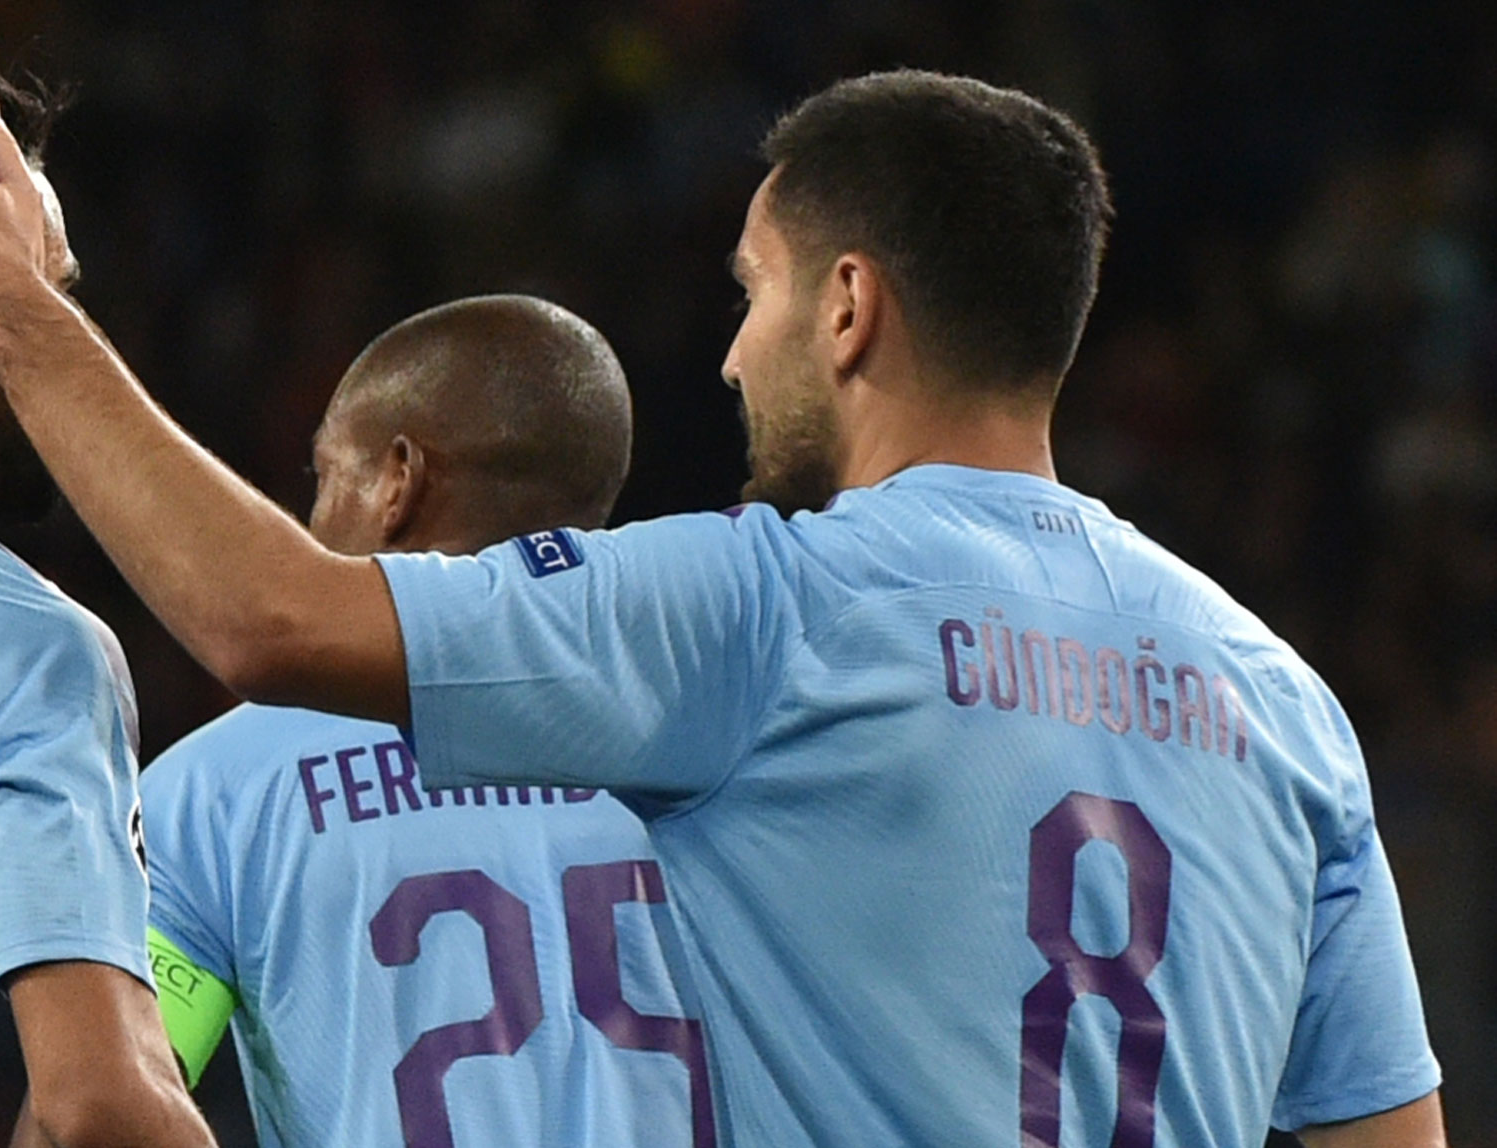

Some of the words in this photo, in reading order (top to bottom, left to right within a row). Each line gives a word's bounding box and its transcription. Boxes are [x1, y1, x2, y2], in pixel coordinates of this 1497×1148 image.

[1032, 511, 1078, 535] CITY
[939, 606, 1248, 763] GÜNDOĞAN
[148, 952, 203, 995] ECT
[369, 860, 716, 1148] 25
[1019, 790, 1172, 1148] 8
